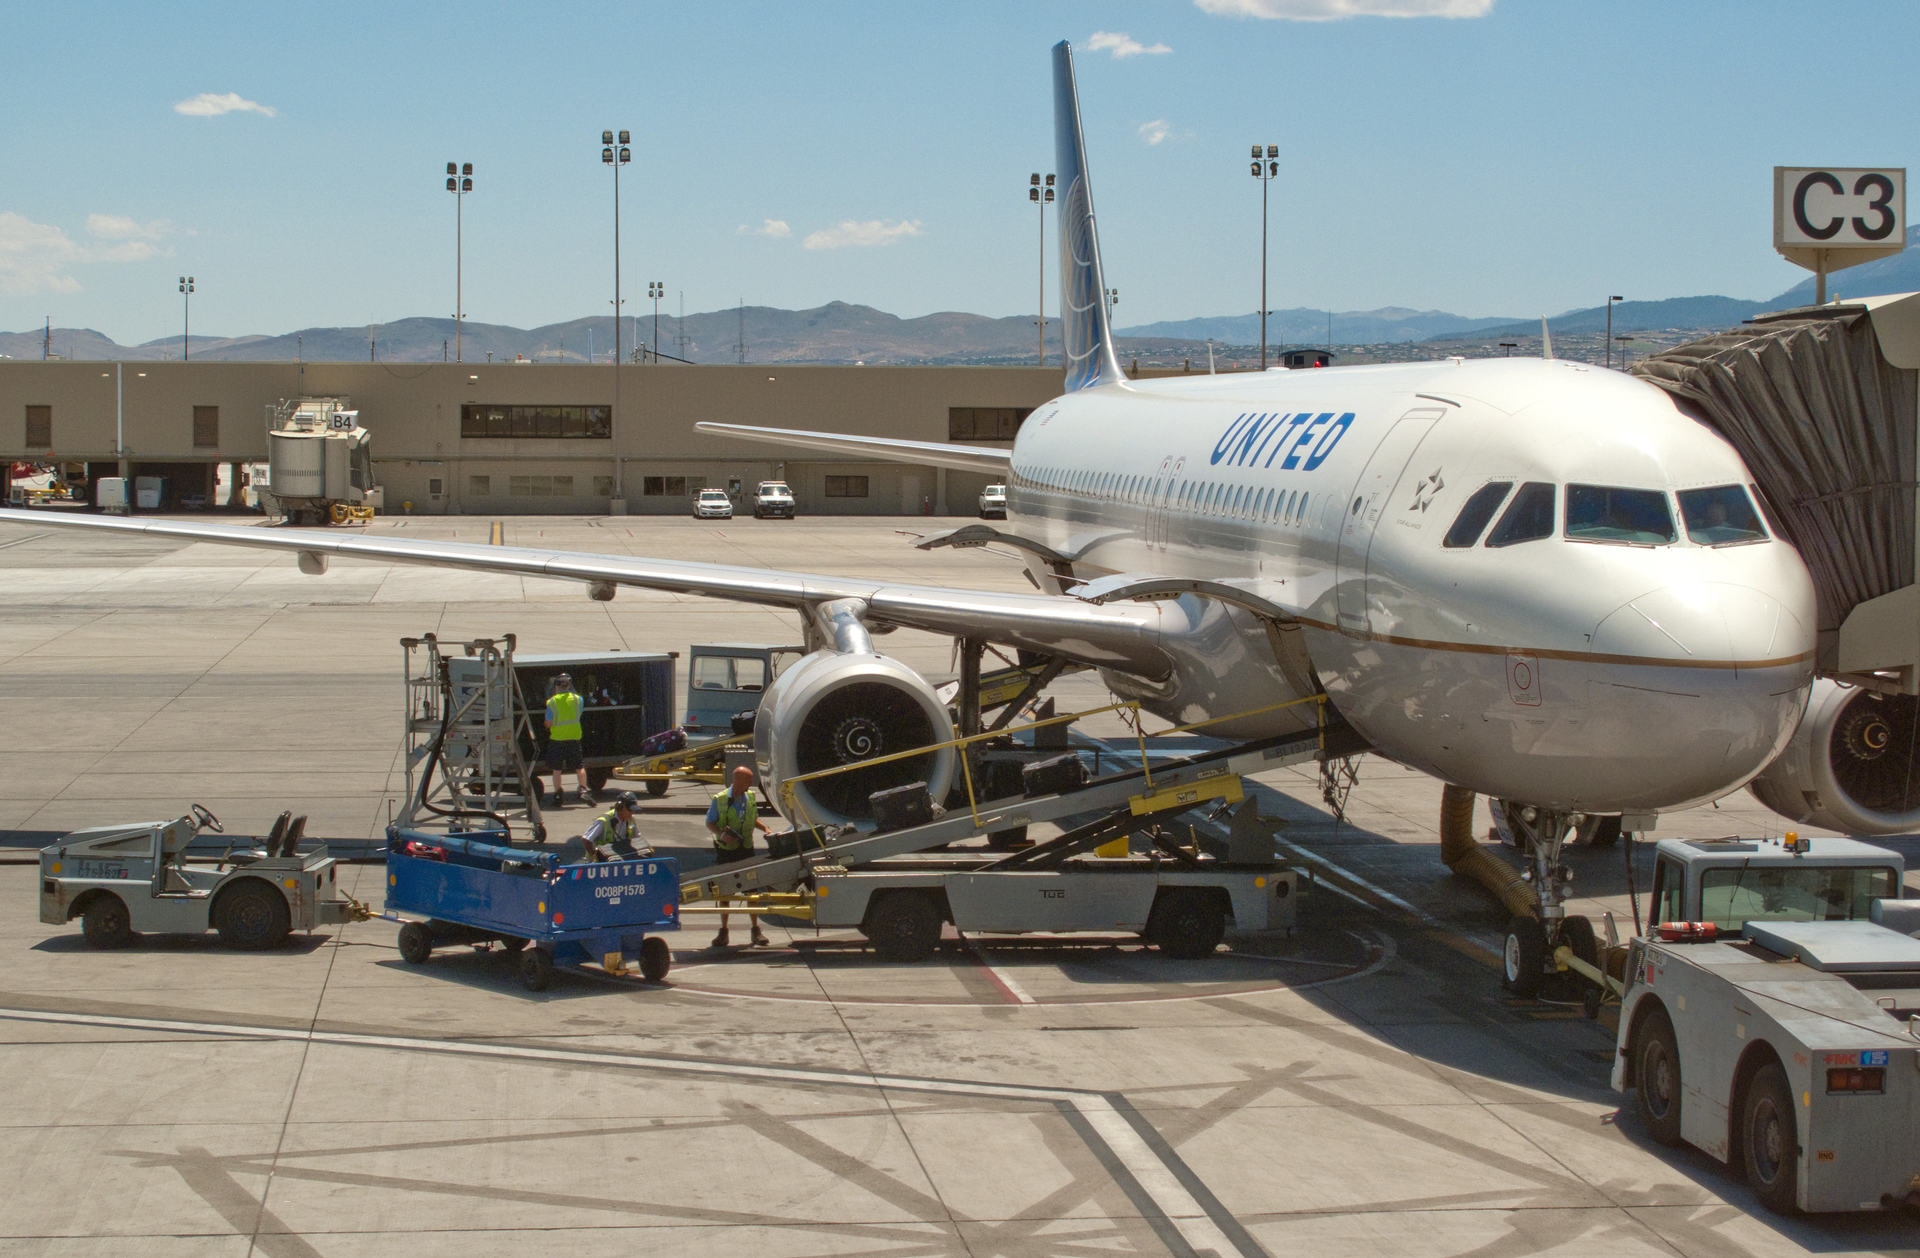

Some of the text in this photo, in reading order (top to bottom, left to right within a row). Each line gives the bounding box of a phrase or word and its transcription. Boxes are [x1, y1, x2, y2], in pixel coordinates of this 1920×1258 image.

[1792, 171, 1896, 241] C3
[334, 415, 352, 429] B4
[1210, 412, 1356, 471] UNITED
[587, 863, 658, 879] UNITED
[1823, 1053, 1857, 1066] FMC
